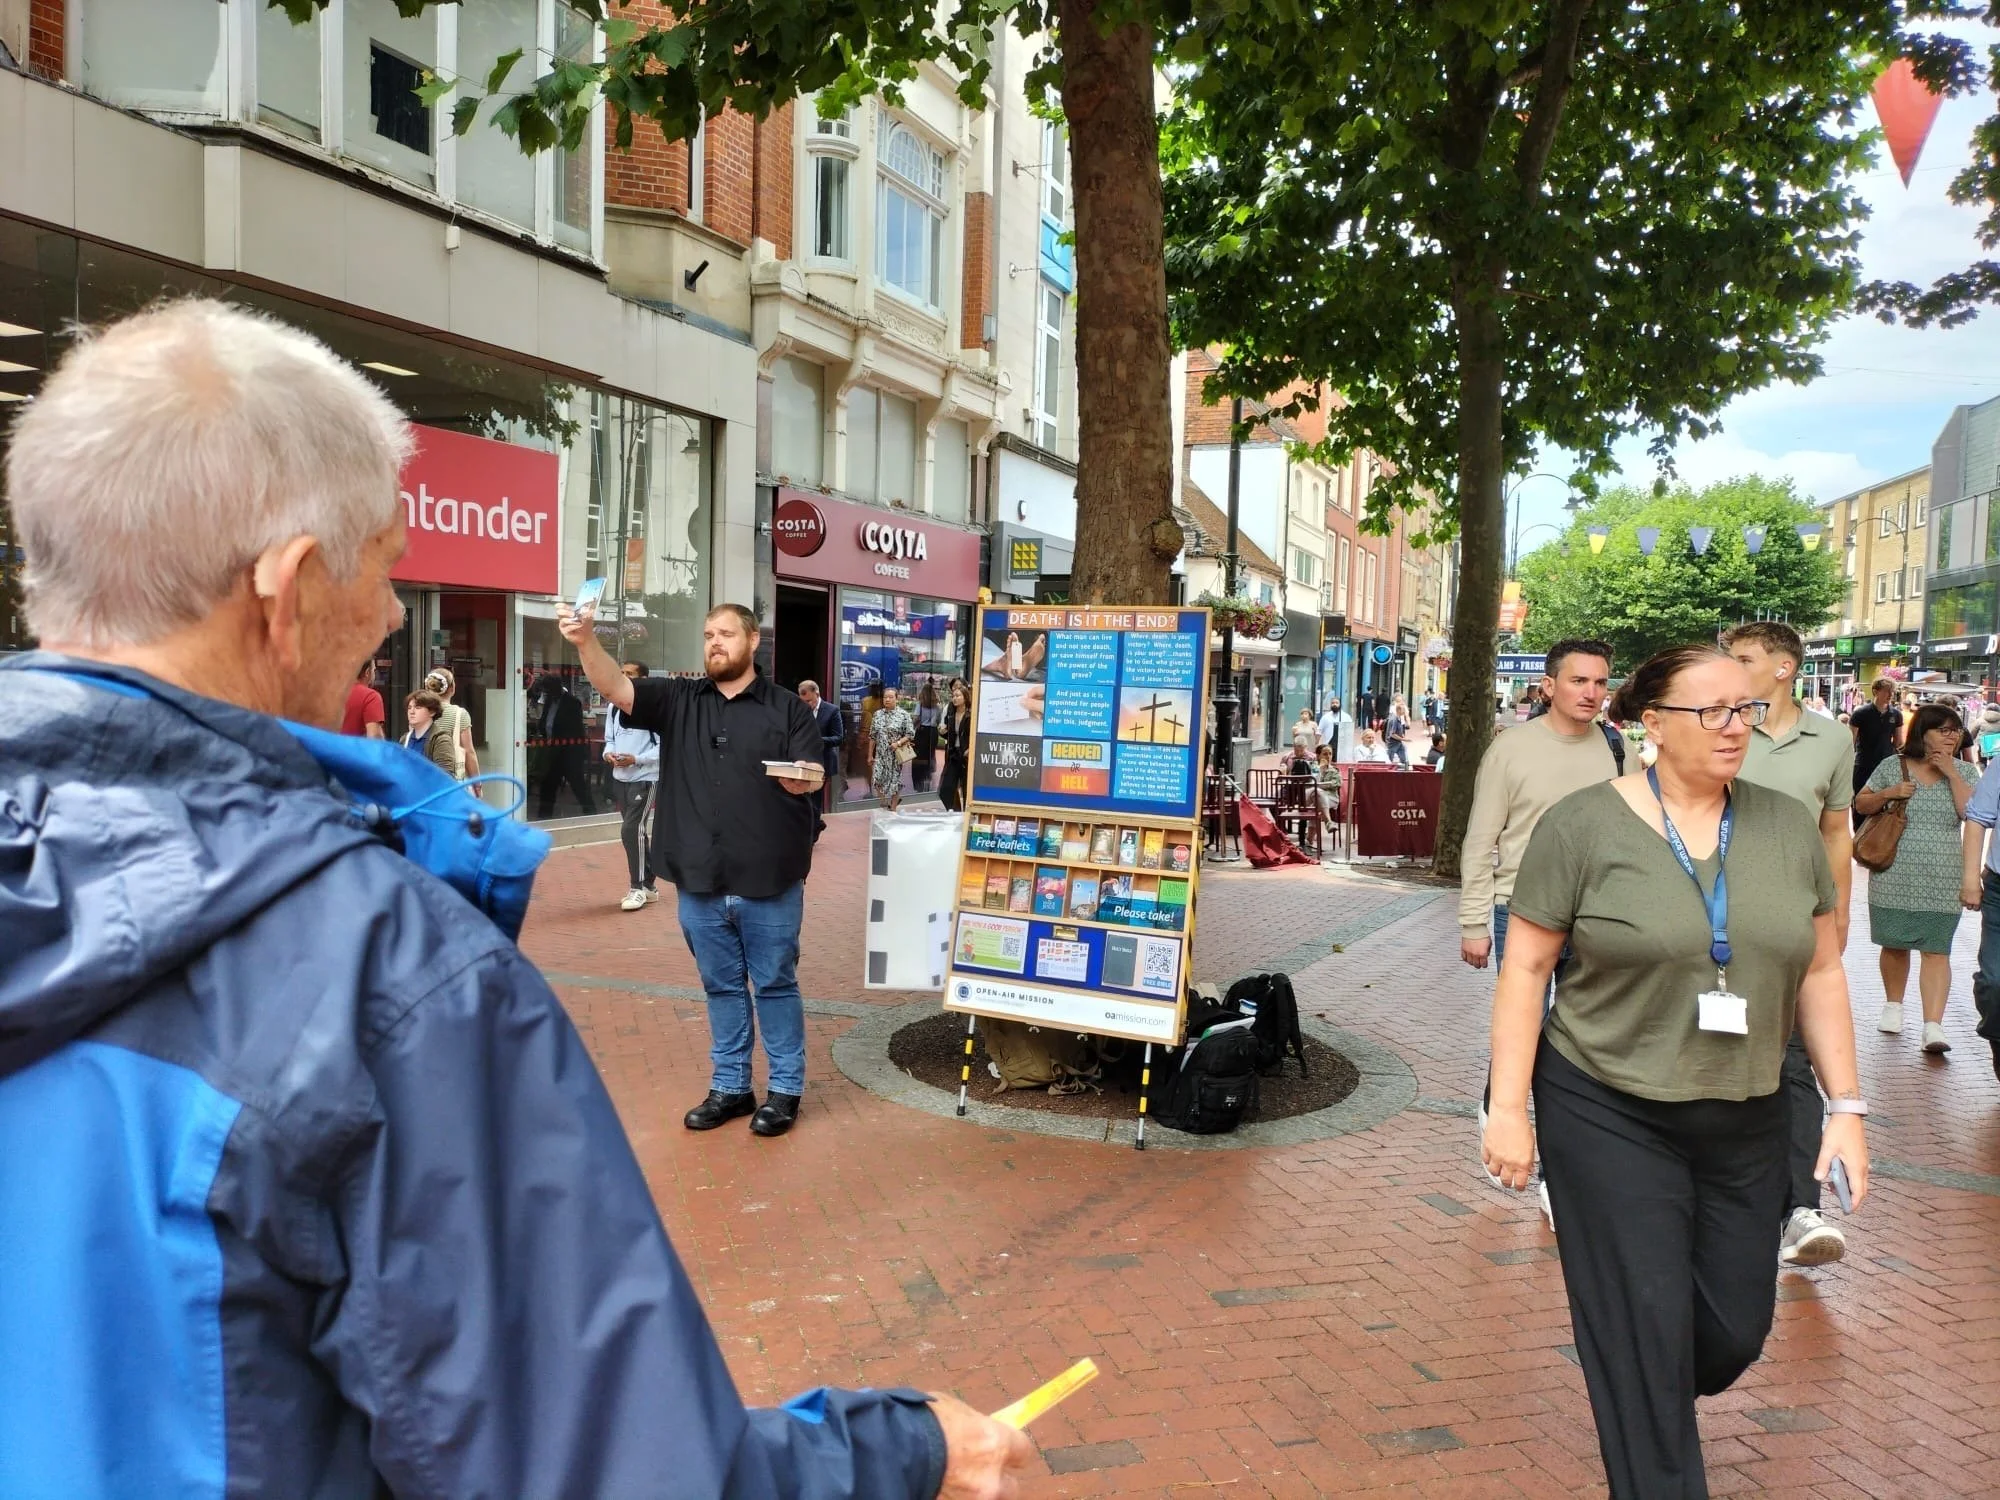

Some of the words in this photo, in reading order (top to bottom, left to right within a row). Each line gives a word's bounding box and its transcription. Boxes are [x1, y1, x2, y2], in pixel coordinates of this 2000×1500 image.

[776, 520, 816, 531] COSTA
[864, 521, 927, 560] COSTA
[874, 562, 910, 579] COFFEE
[1009, 612, 1062, 626] DEATH:
[1069, 613, 1083, 626] IS
[1086, 613, 1099, 627] IT
[1103, 614, 1132, 628] THE
[1136, 614, 1177, 629] END?
[1055, 632, 1072, 640] What
[1148, 650, 1166, 658] sting?
[1805, 643, 1836, 658] Superdrug
[1099, 653, 1115, 661] from
[1496, 660, 1514, 671] AMS
[1520, 660, 1546, 671] FRESH
[1071, 671, 1093, 680] grave?
[1157, 668, 1180, 676] through
[988, 741, 1030, 754] WHERE
[1053, 743, 1100, 760] HEAVEN
[1011, 756, 1037, 767] YOU
[1070, 761, 1081, 774] OR
[995, 767, 1020, 779] GO?
[1122, 773, 1145, 781] Everyone
[1060, 775, 1089, 790] HELL
[1390, 809, 1427, 820] COSTA
[976, 836, 996, 848] Free
[997, 838, 1031, 851] leaflets
[1114, 905, 1147, 919] Please
[1148, 910, 1175, 922] take!
[1144, 978, 1156, 986] FREE
[1156, 980, 1172, 988] BIBLE
[976, 987, 1016, 999] OPEN-AIR
[1018, 993, 1055, 1005] MISSION
[1104, 1011, 1167, 1026] oamission.com
